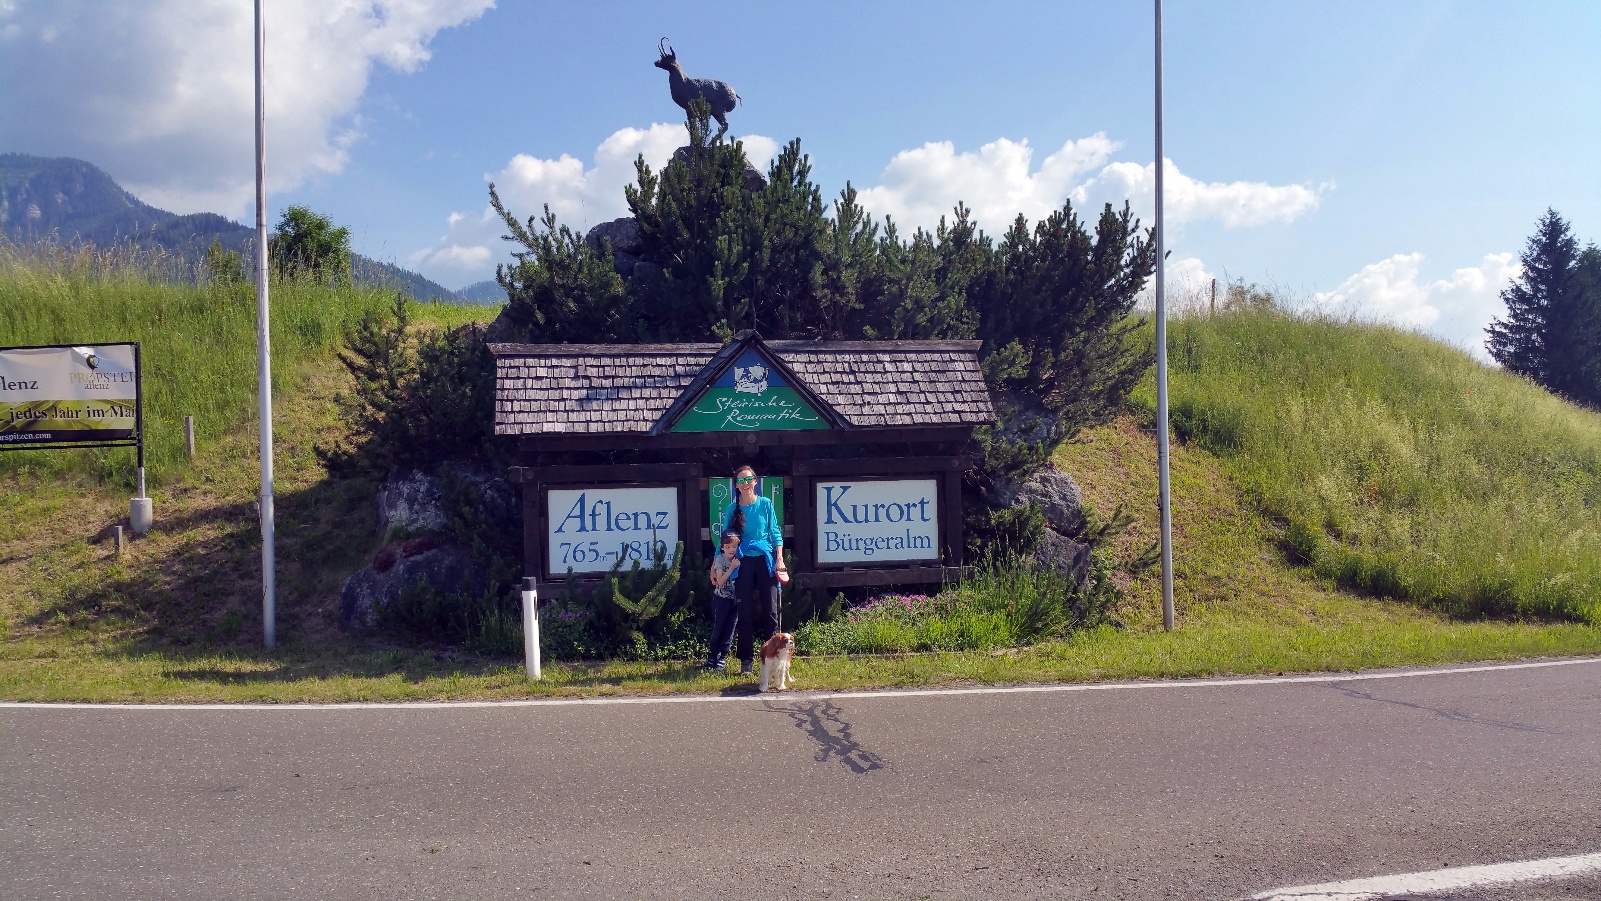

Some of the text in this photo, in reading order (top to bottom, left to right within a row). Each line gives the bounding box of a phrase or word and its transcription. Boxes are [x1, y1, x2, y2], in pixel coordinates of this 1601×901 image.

[0, 375, 39, 391] lenz
[69, 371, 134, 384] PROPSTEI
[9, 405, 135, 424] jedes Jahr im Mai
[693, 396, 795, 414] Steirische
[721, 407, 819, 428] Romantik
[553, 492, 670, 533] Aflenz
[822, 485, 932, 525] Kurort
[823, 528, 933, 556] Bürgeralm
